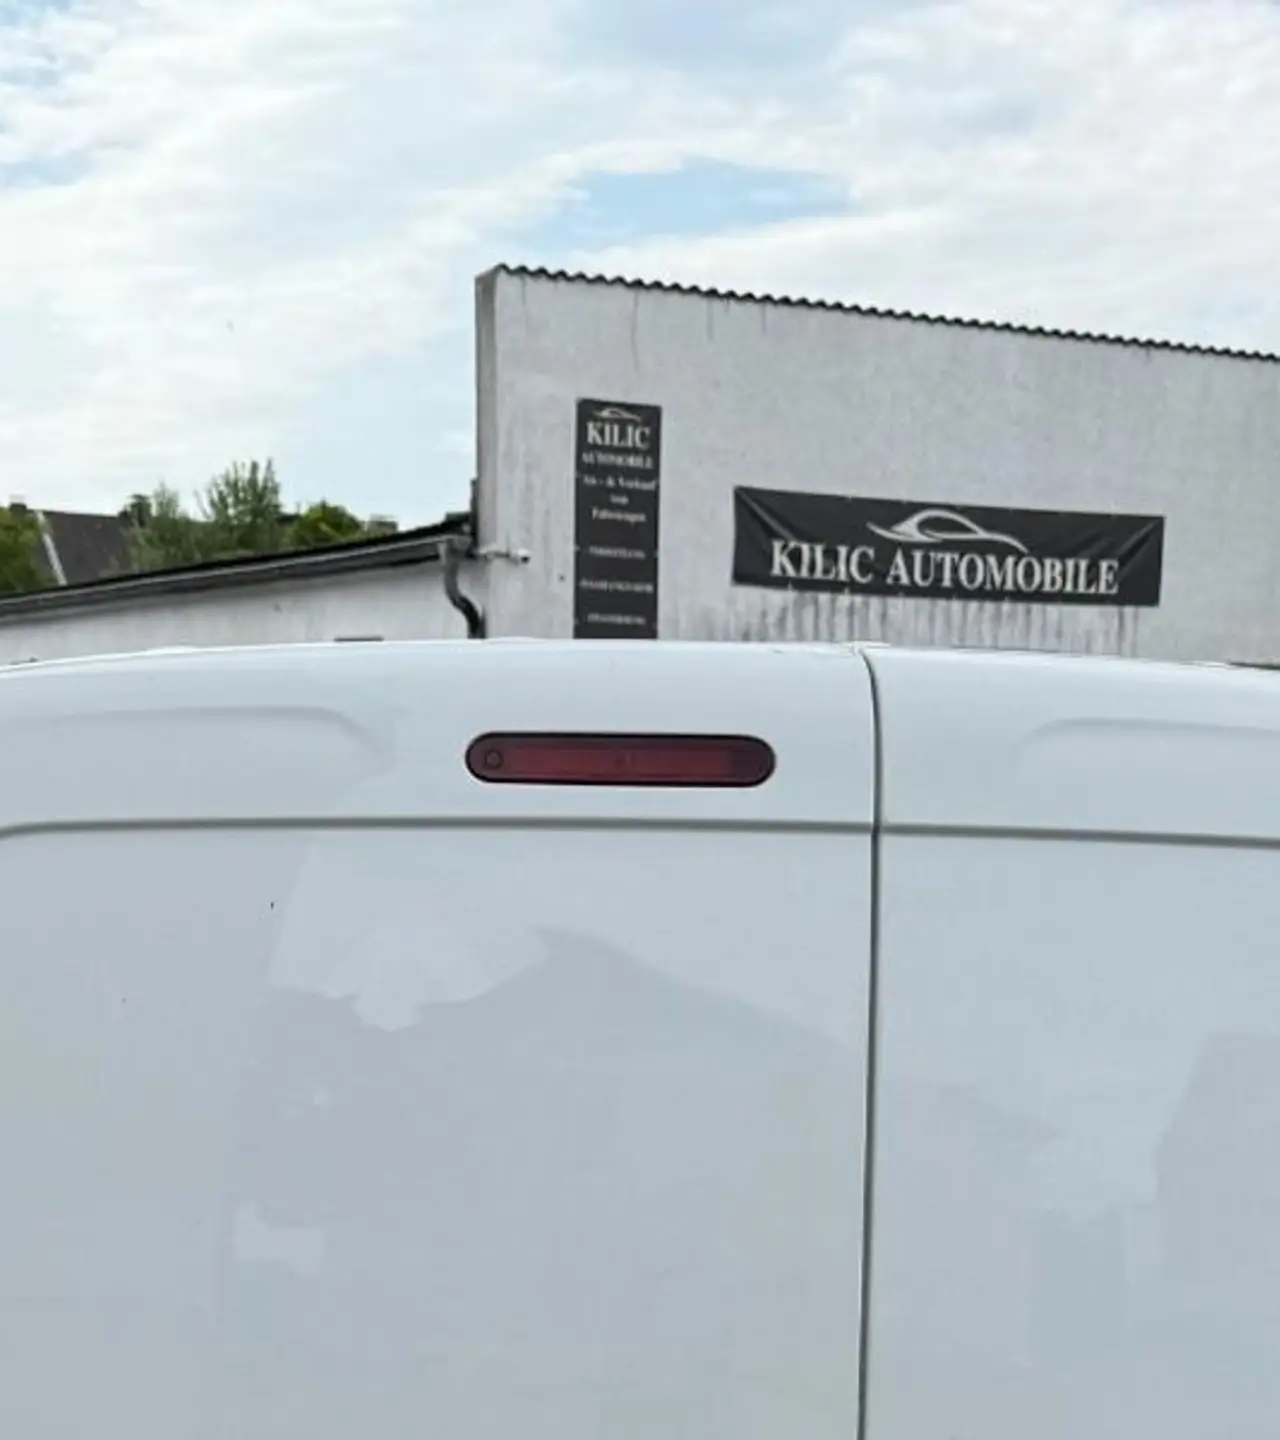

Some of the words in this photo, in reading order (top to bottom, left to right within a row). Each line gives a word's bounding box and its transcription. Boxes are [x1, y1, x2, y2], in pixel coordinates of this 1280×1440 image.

[586, 421, 651, 451] KILIC
[769, 538, 874, 584] KILIC
[886, 548, 1119, 595] AUTOMOBILE
